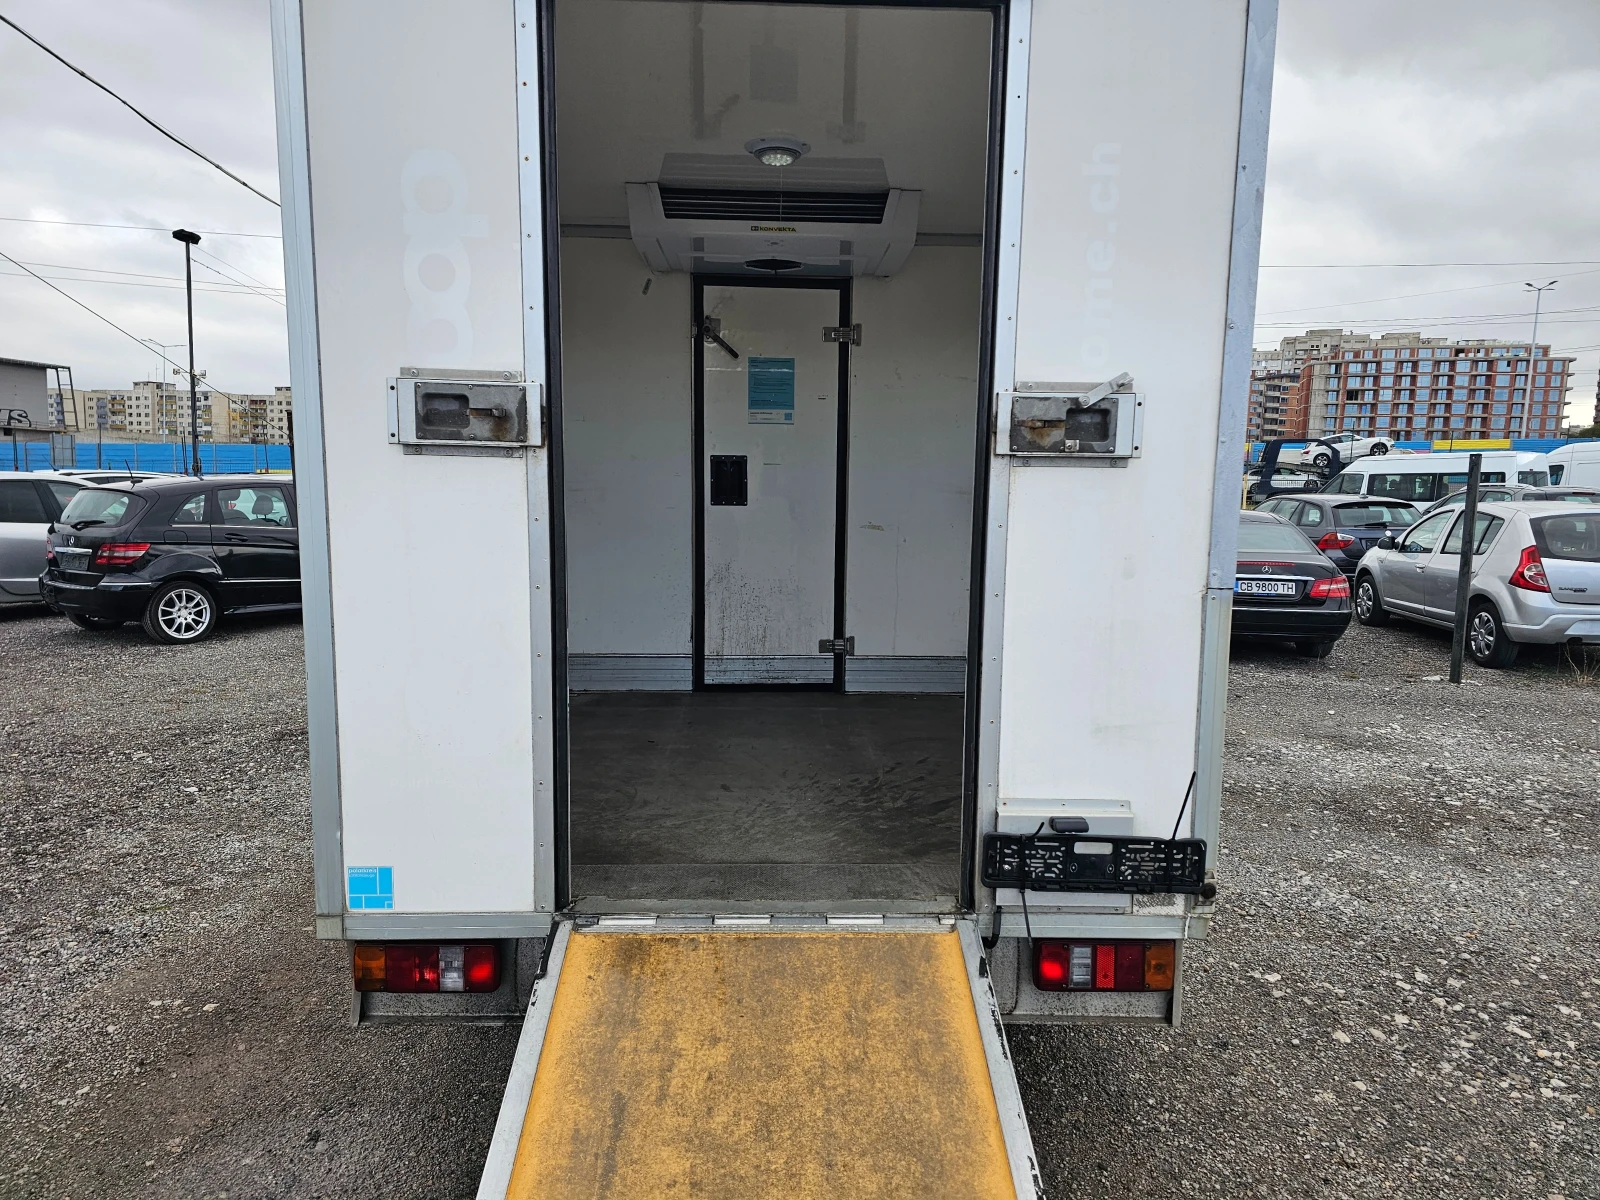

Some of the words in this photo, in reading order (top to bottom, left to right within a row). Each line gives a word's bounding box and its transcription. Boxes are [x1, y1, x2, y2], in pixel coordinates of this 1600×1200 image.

[1240, 581, 1253, 592] CB
[1255, 582, 1279, 593] 9800
[1280, 583, 1294, 594] TH
